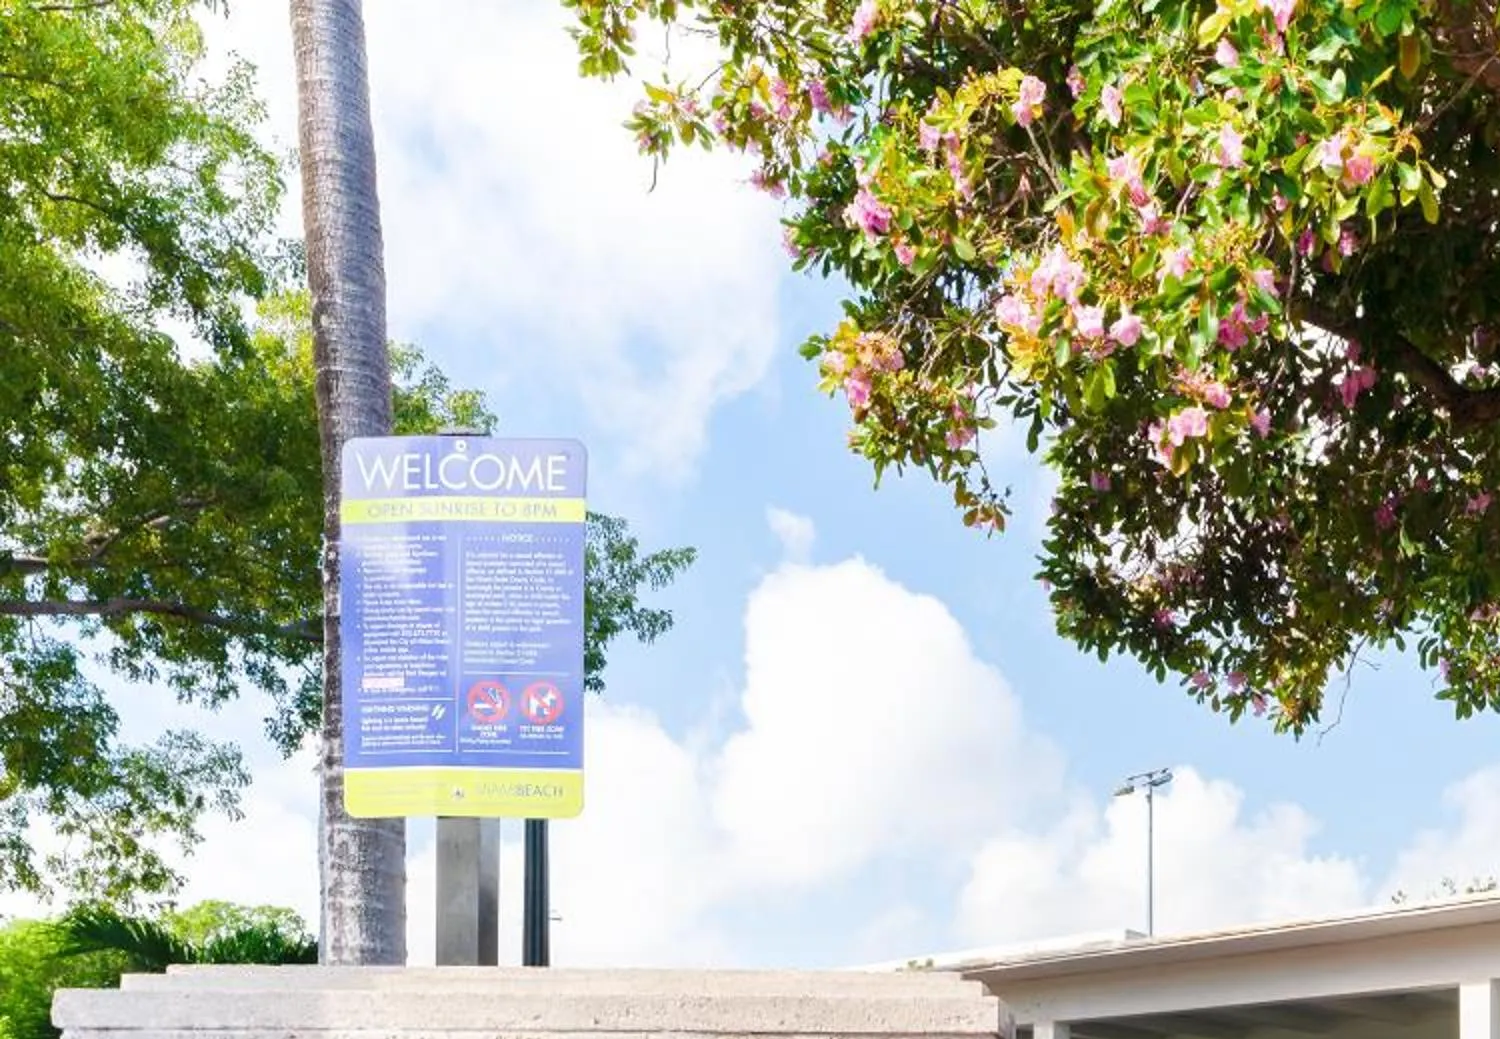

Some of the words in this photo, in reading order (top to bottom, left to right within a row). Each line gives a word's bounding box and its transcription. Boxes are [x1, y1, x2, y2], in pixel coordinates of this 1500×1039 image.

[355, 451, 568, 491] WELCOME
[367, 502, 413, 518] OPEN
[419, 501, 486, 516] SUNRISE
[494, 502, 516, 516] TO
